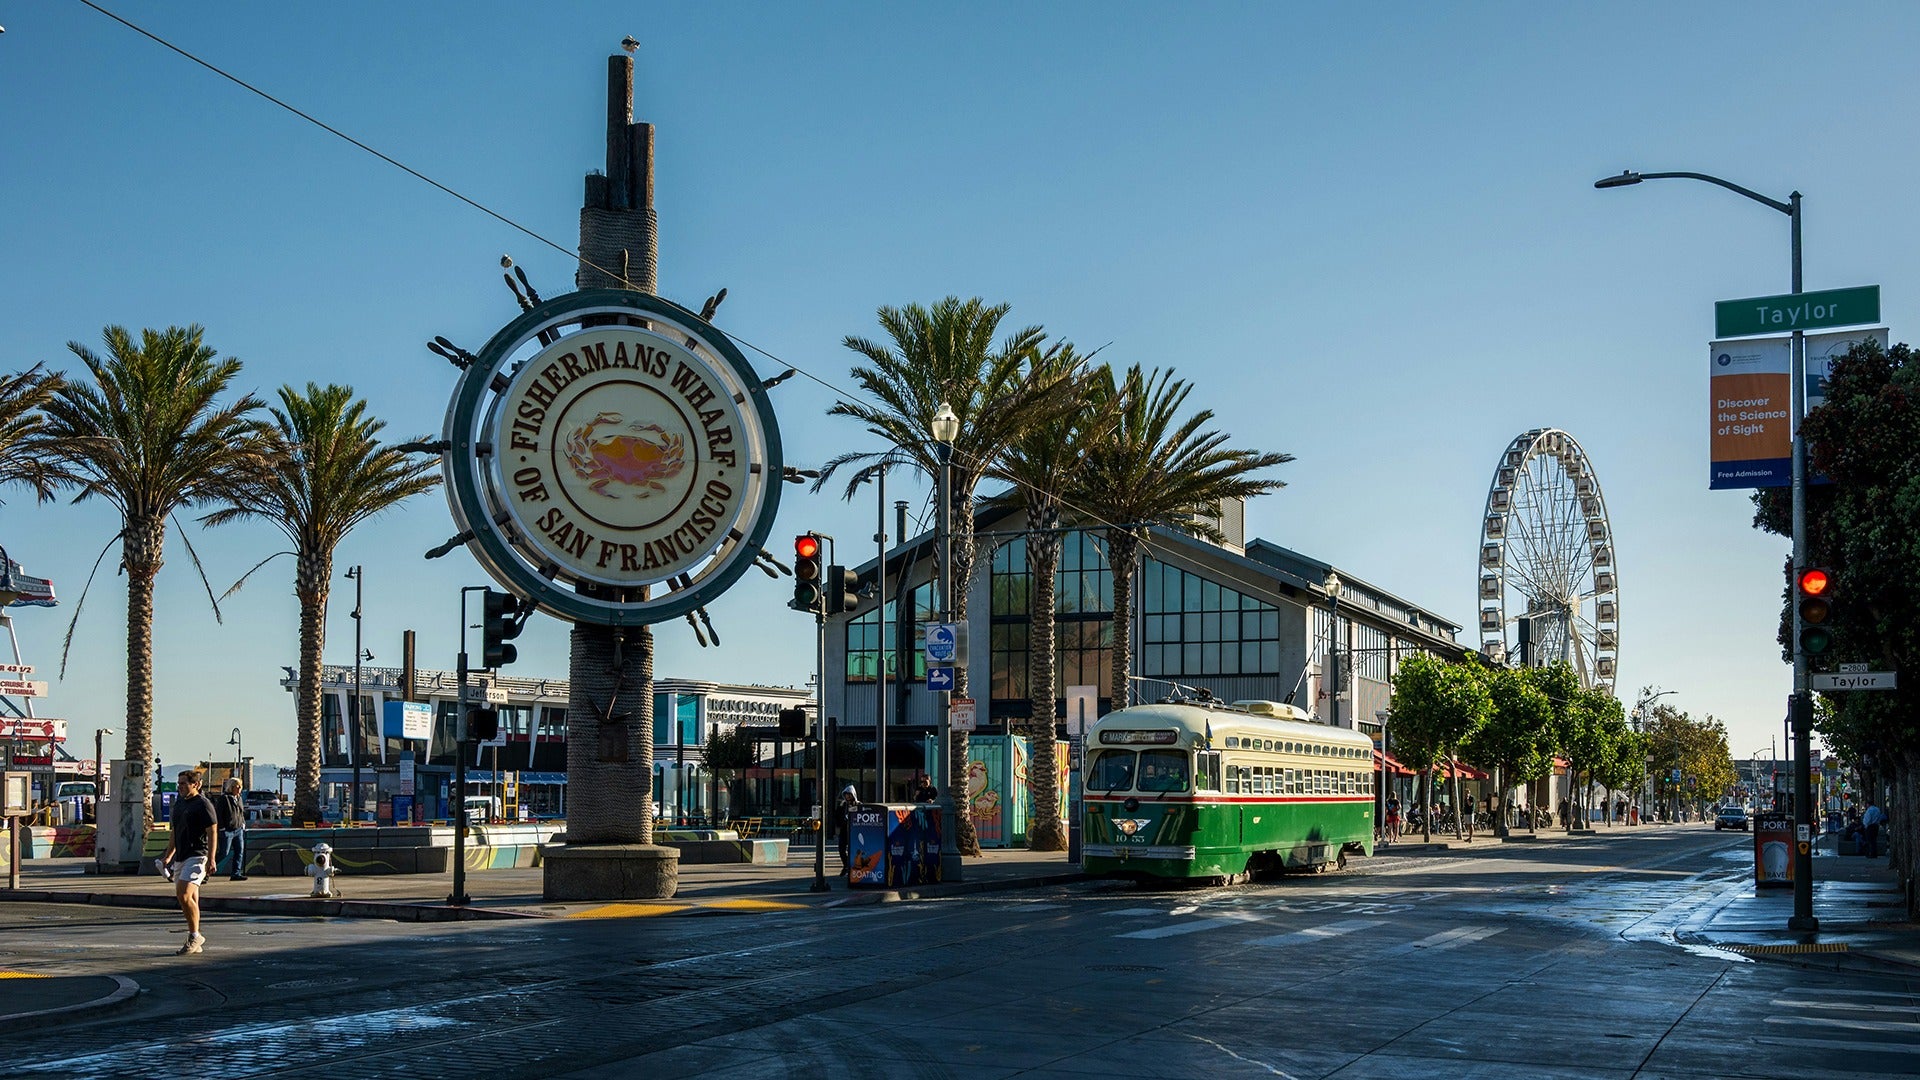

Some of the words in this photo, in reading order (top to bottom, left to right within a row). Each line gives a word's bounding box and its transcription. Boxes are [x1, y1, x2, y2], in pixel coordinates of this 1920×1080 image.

[1757, 303, 1837, 326] Taylor
[510, 341, 672, 453] FISHERMANS
[670, 361, 736, 468] WHARF
[1717, 398, 1770, 409] Discover
[1717, 413, 1737, 422] the
[1739, 410, 1788, 420] Science
[1717, 426, 1731, 436] of
[1733, 424, 1764, 436] Sight
[1717, 471, 1734, 479] Free
[1735, 469, 1773, 478] Admission
[513, 466, 549, 503] OF
[535, 506, 594, 559] SAN
[596, 478, 733, 572] FRANCISCO
[7, 665, 17, 673] 43
[1831, 676, 1877, 689] Taylor
[470, 688, 505, 700] Jefferson
[856, 813, 880, 823] PORT
[1763, 820, 1787, 830] PORT
[852, 870, 883, 879] BOATING
